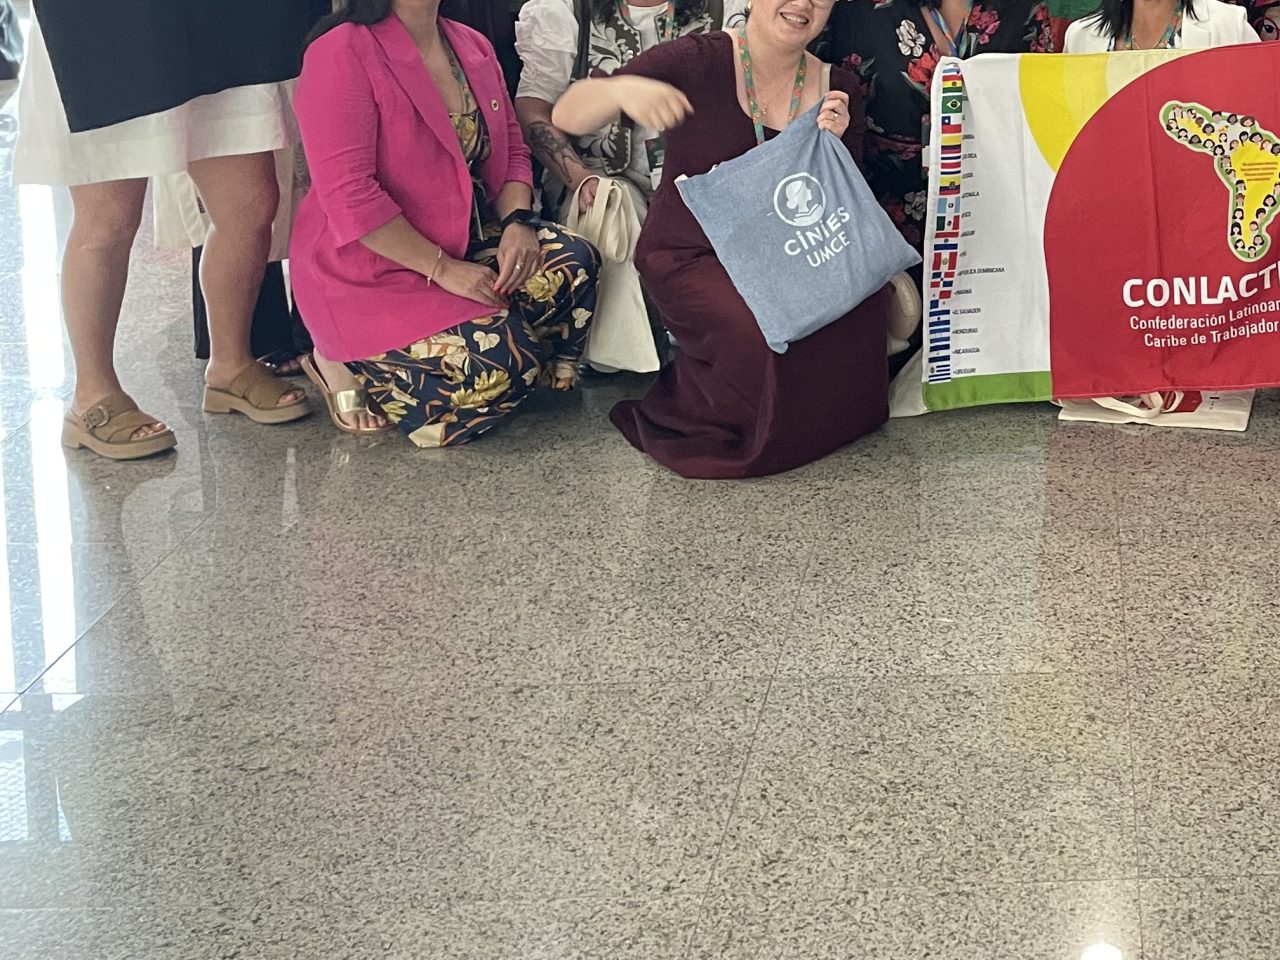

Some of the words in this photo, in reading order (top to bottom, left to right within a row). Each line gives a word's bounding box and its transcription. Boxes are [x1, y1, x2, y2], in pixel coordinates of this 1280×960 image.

[806, 231, 851, 268] UMCE
[1129, 314, 1226, 340] Confederación
[1144, 333, 1188, 348] Caribe
[1190, 331, 1207, 345] de
